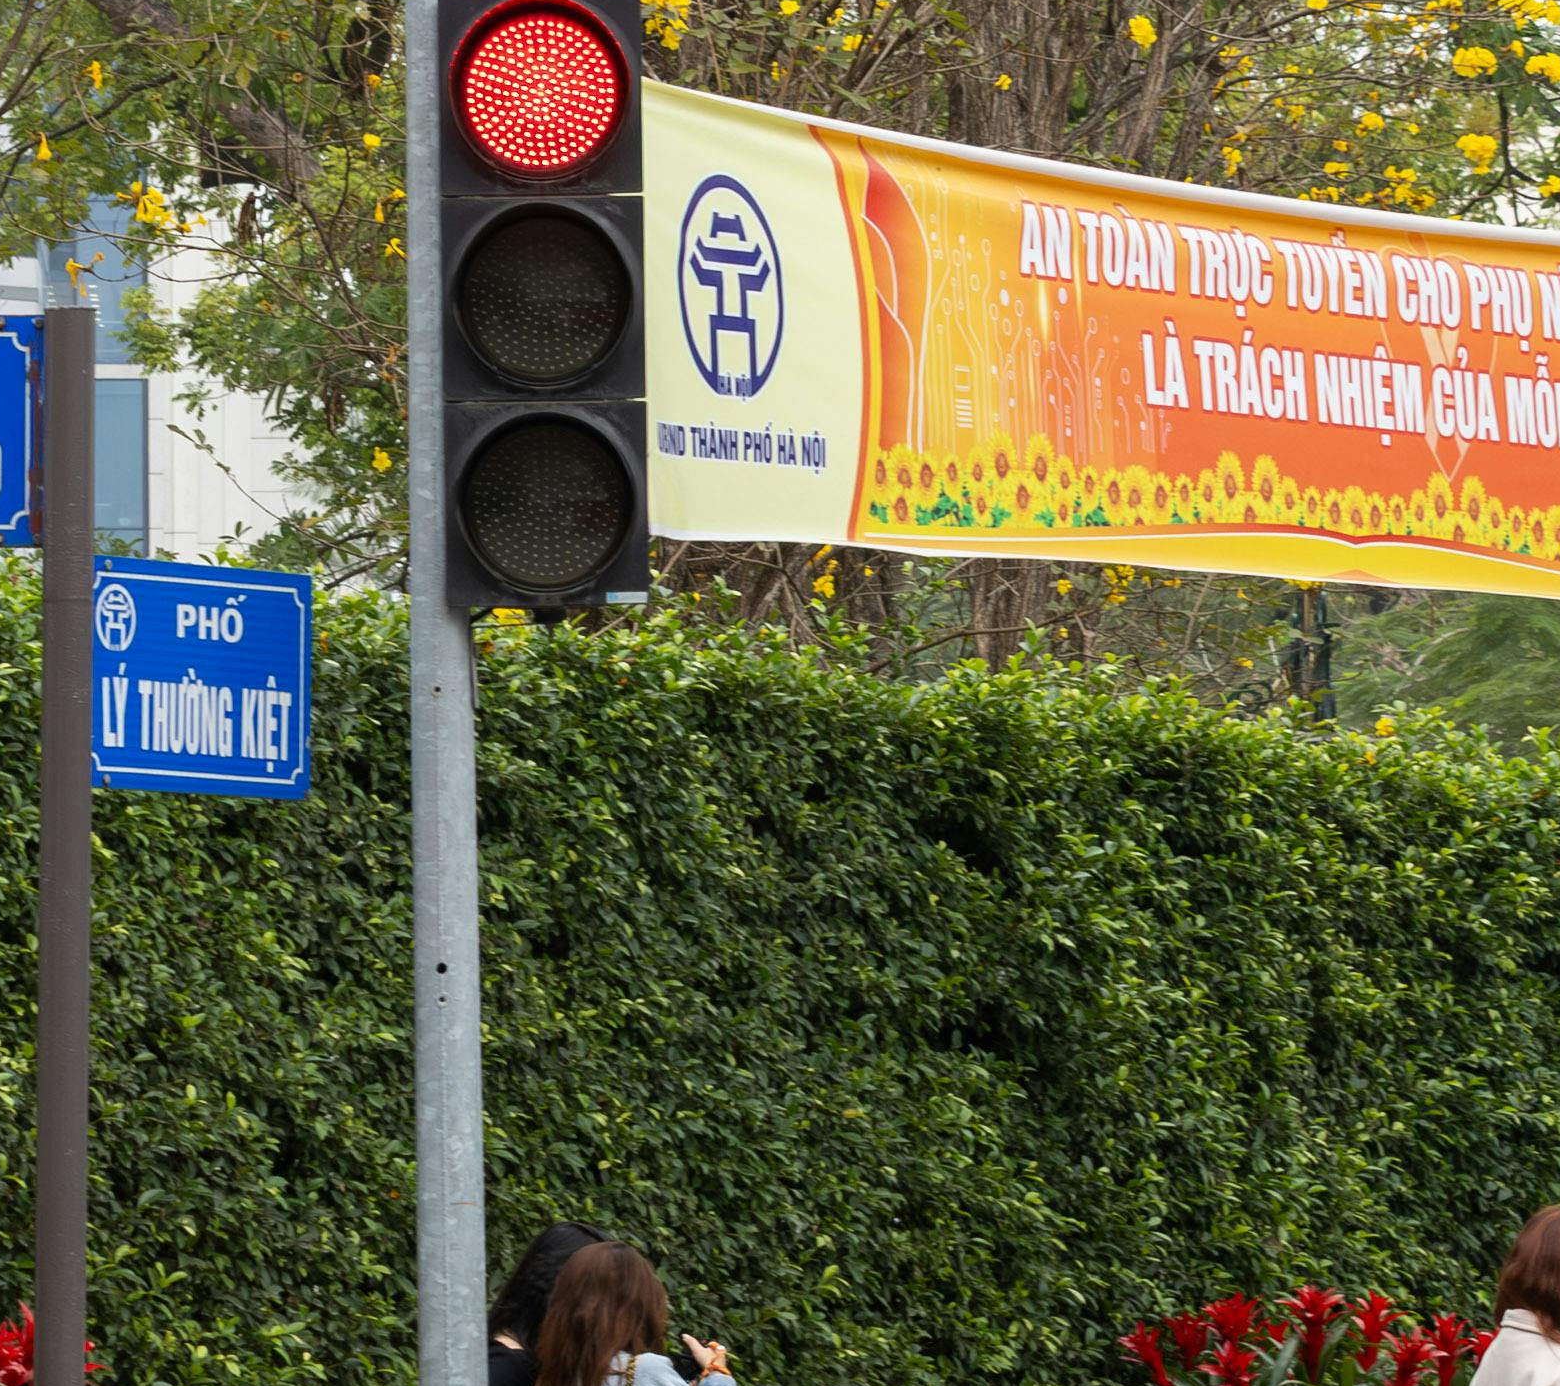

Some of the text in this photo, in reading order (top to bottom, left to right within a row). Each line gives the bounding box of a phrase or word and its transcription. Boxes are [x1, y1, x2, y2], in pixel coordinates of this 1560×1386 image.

[1020, 202, 1072, 280] AN
[1076, 203, 1176, 293] TOÀN
[1177, 226, 1274, 317] TRỰC
[1391, 254, 1461, 328] CHO
[1462, 264, 1533, 352] PHỤ
[1141, 319, 1189, 408] LÀ
[1192, 329, 1308, 421] TRÁCH
[1314, 345, 1426, 446] NHIỆM
[1431, 346, 1500, 442] CỦA
[690, 421, 738, 461] THÀNH
[744, 422, 773, 463] PHỐ
[777, 428, 797, 465] HÀ
[801, 431, 826, 474] NỘI
[176, 594, 248, 643] PHỐ
[102, 662, 292, 773] LÝ THƯỜNG KIỆT
